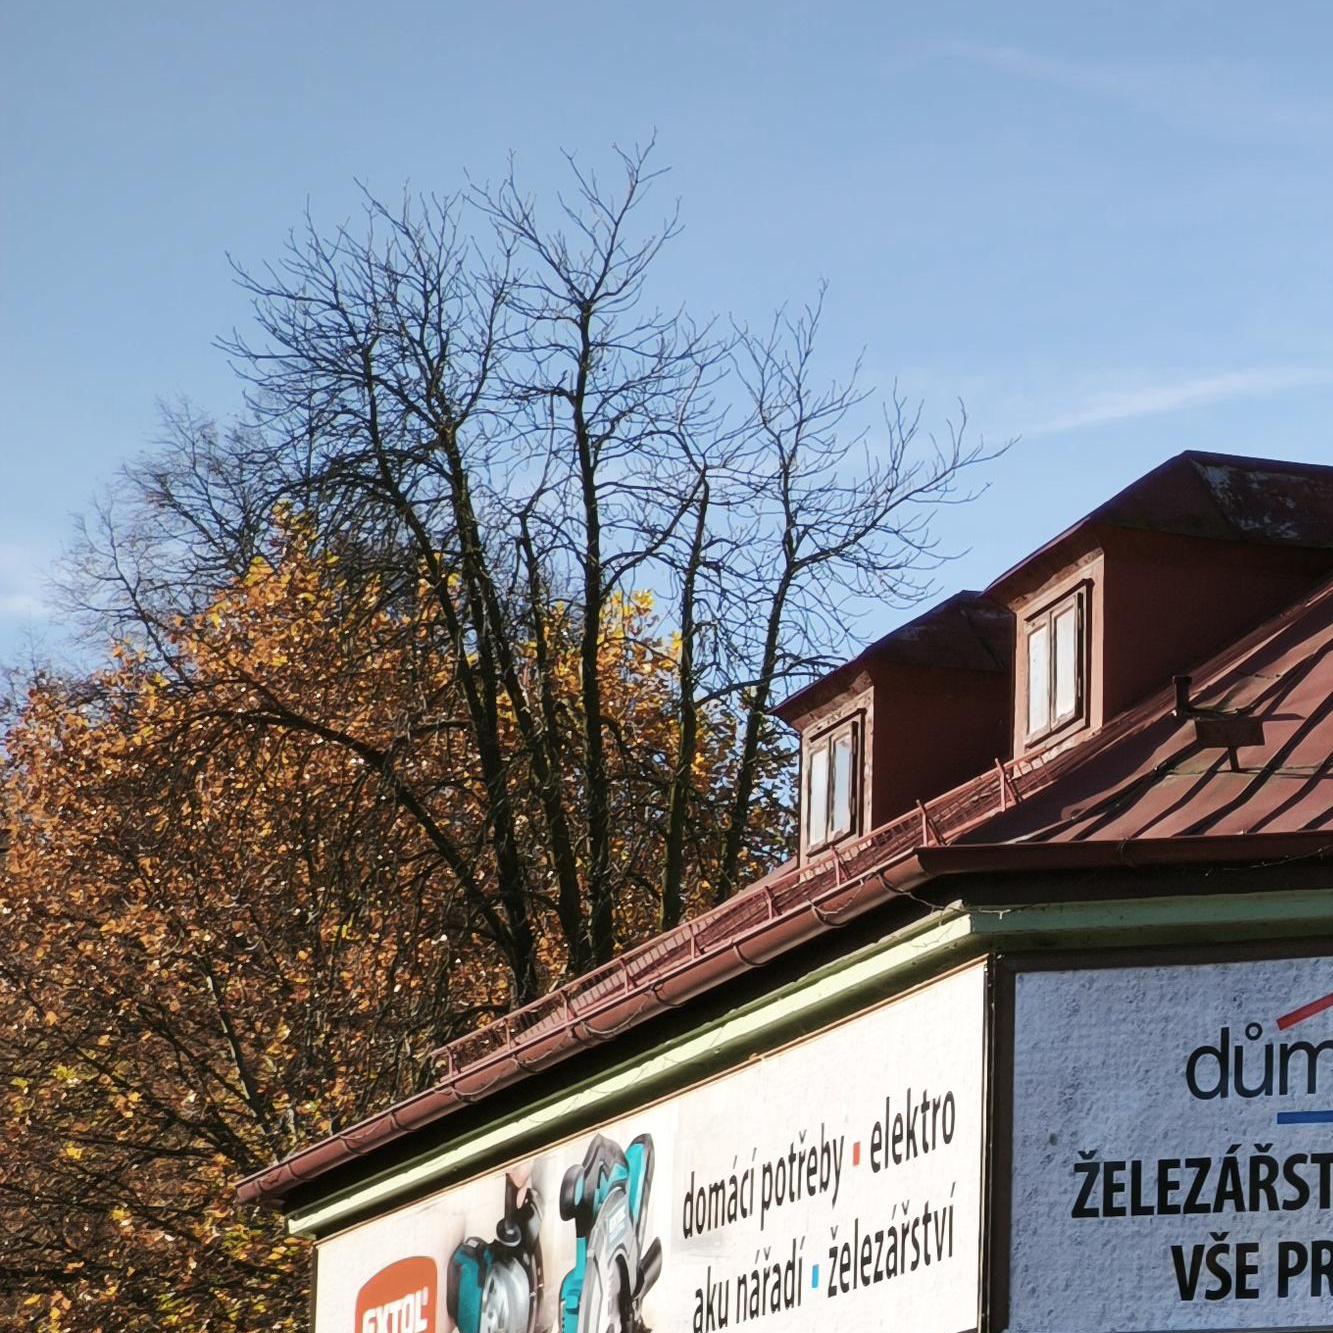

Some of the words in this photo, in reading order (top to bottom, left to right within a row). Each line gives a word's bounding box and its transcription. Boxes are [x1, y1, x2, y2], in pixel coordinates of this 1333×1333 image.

[682, 1147, 757, 1239] domácí
[760, 1122, 845, 1231] potřeby
[870, 1088, 956, 1173] elektro
[736, 1236, 805, 1324] nářadí
[828, 1181, 956, 1298] železářství
[1170, 1231, 1260, 1302] VŠE
